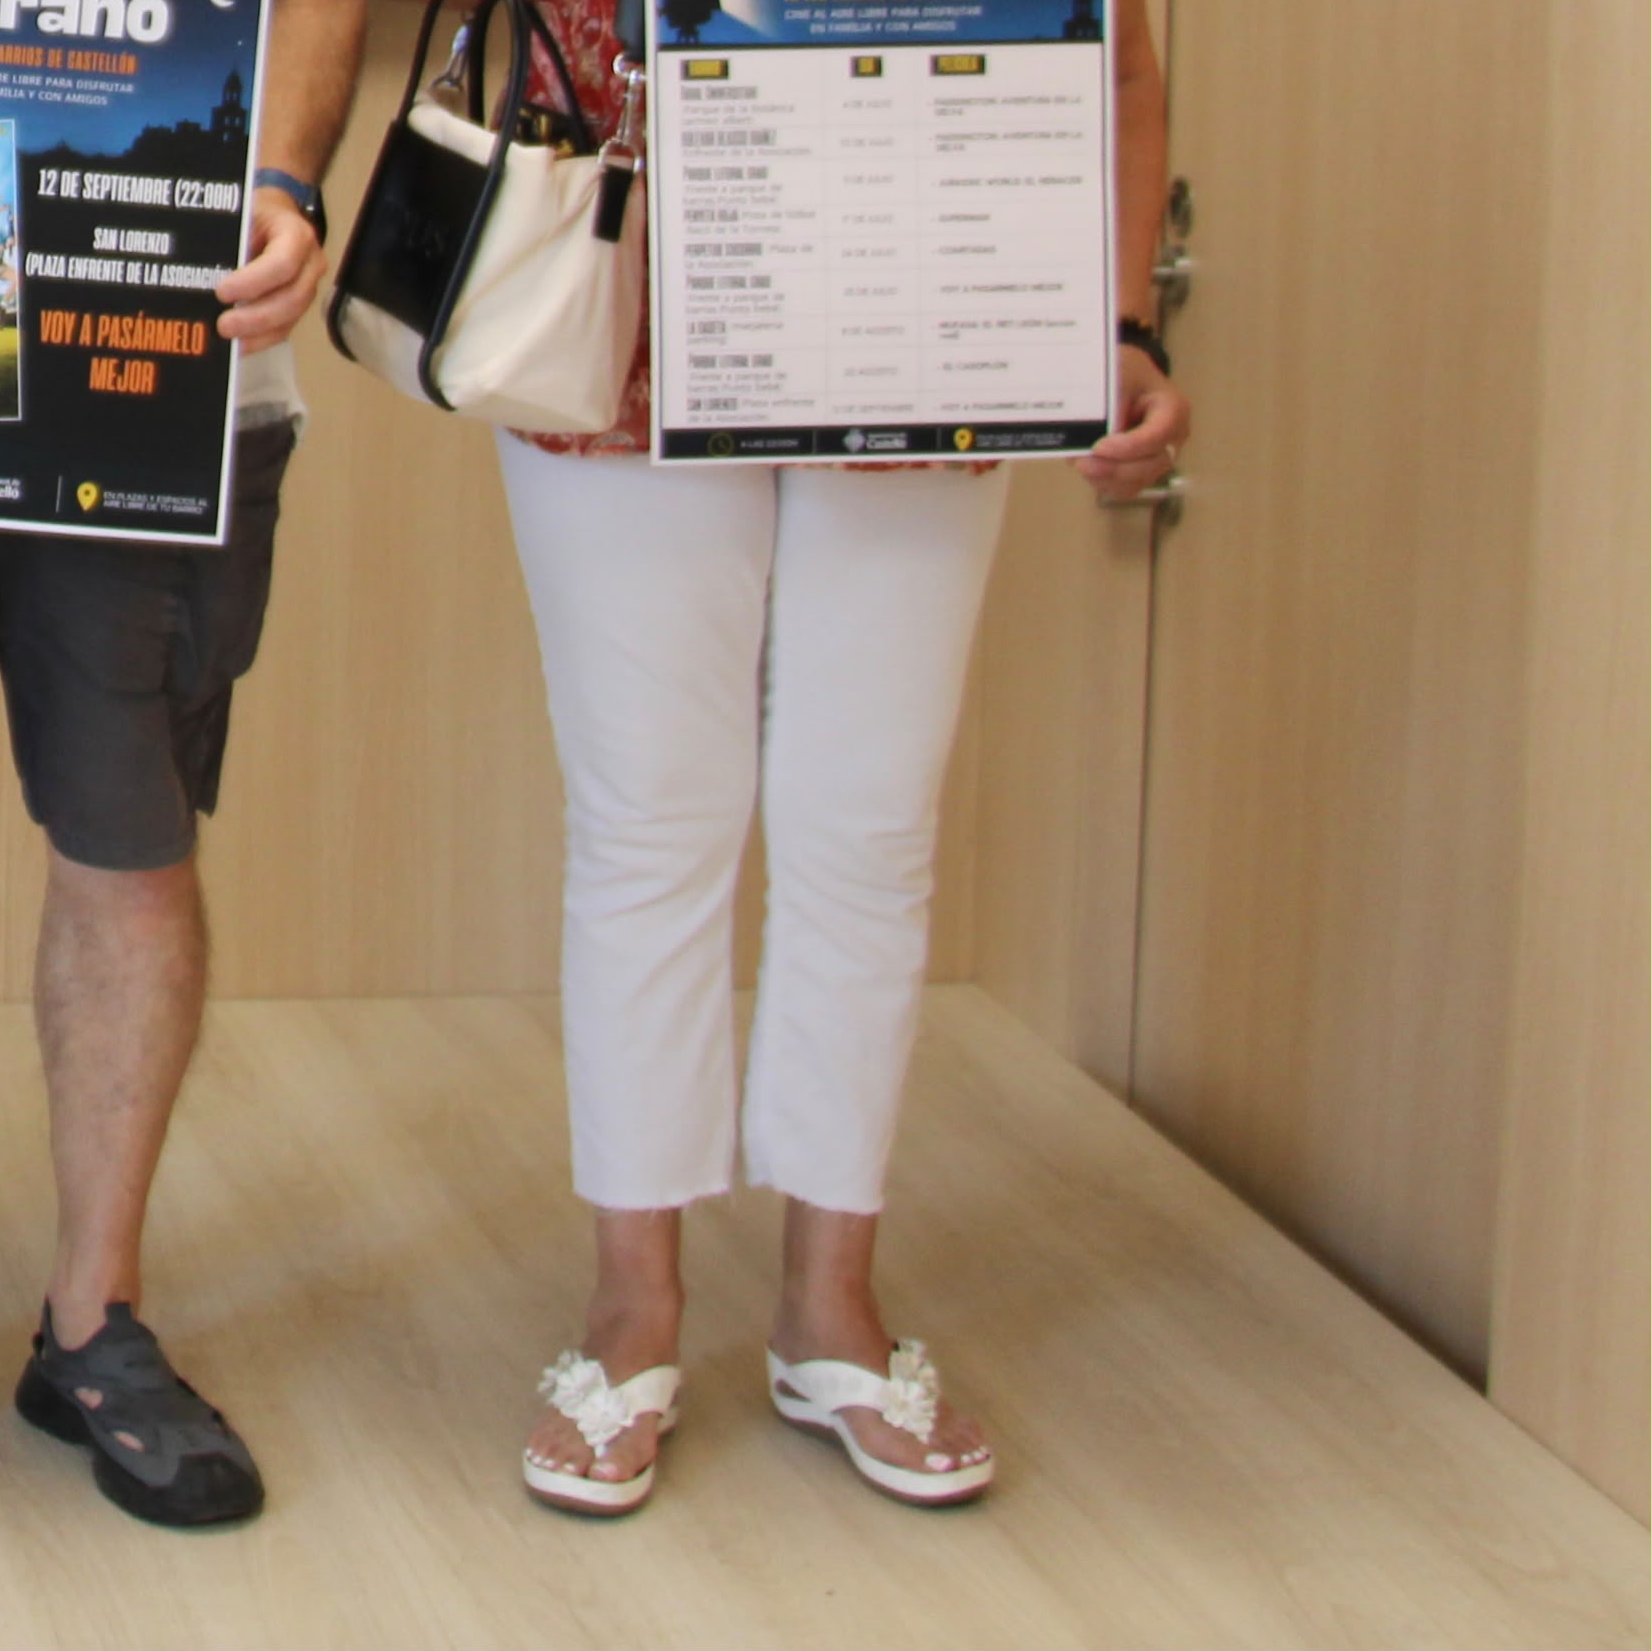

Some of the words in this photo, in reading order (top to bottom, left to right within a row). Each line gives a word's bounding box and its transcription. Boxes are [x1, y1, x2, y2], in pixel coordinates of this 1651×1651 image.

[37, 169, 58, 196] 12
[62, 171, 79, 197] DE
[82, 173, 172, 204] SEPTIEMBRE
[94, 229, 115, 251] SAN
[119, 231, 170, 255] LORENZO
[26, 255, 65, 279] (PLAZA
[68, 258, 123, 282] ENFRENTE
[126, 262, 141, 283] DE
[144, 263, 159, 284] LA
[40, 310, 75, 345] VOY
[79, 314, 92, 347] A
[97, 309, 206, 356] PASÁRMELO
[89, 357, 155, 394] MEJOR
